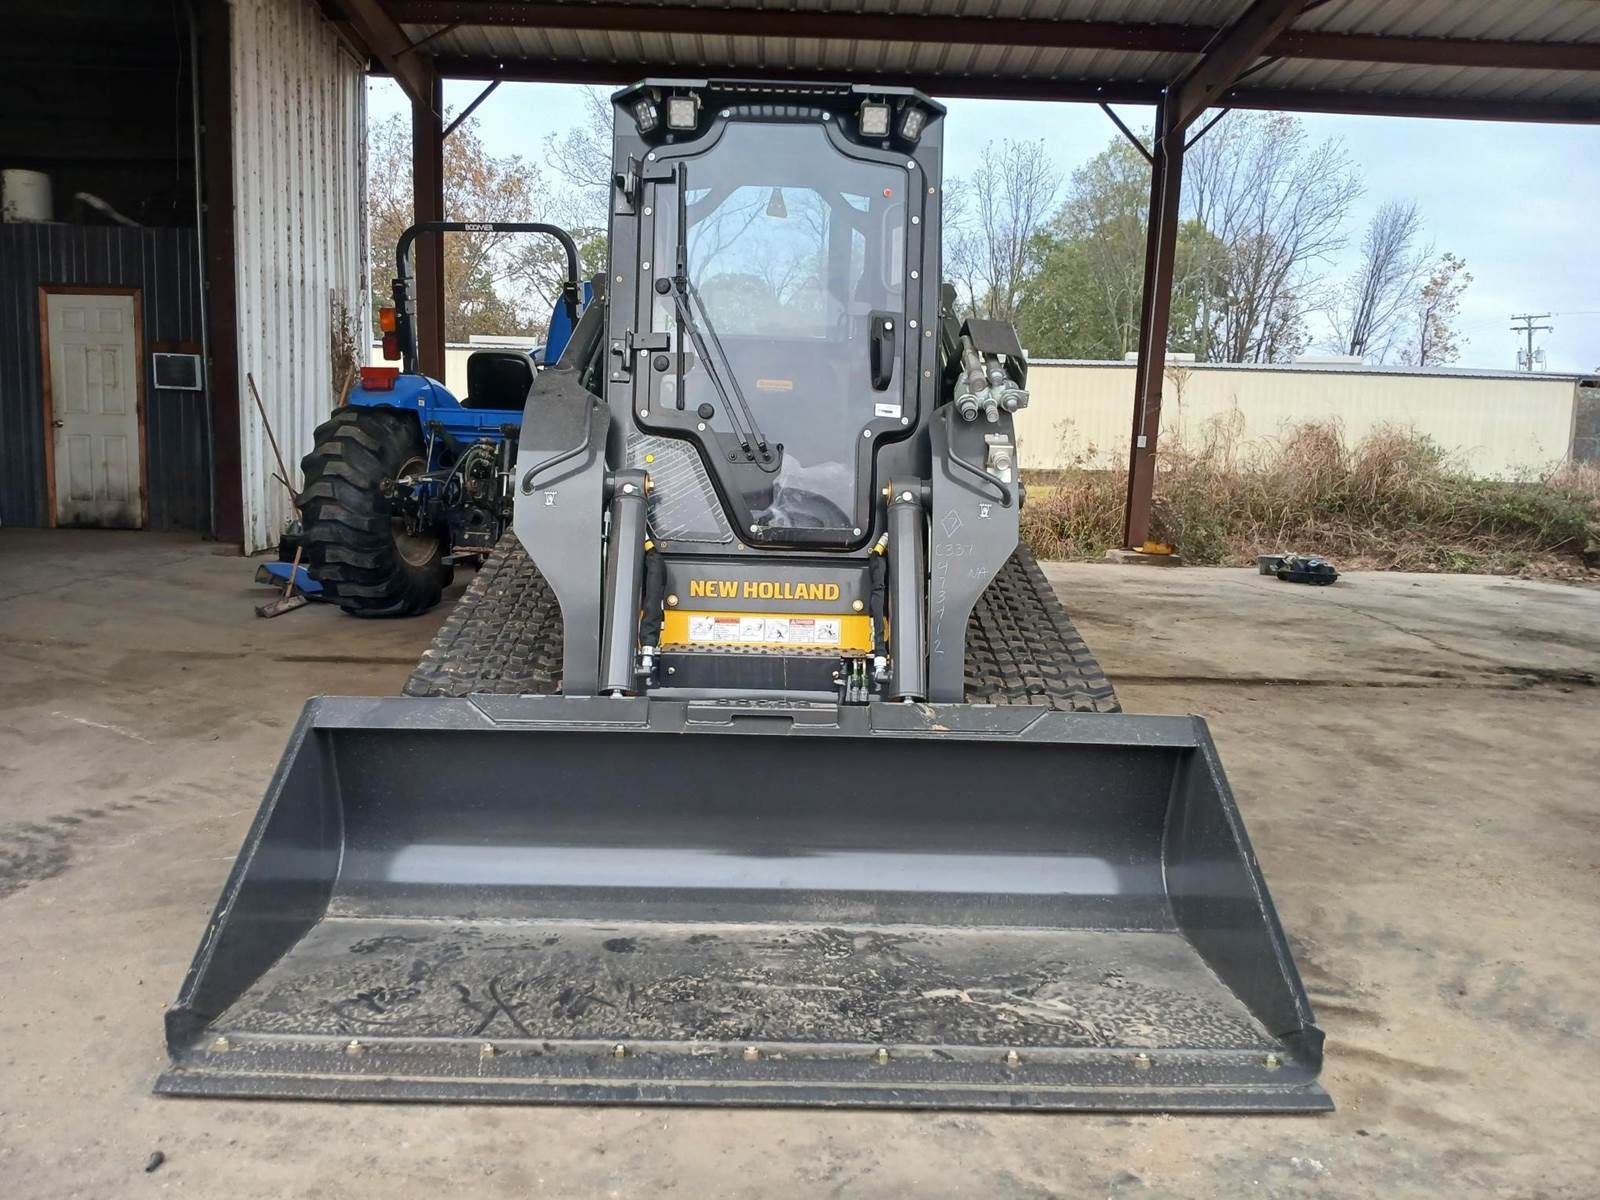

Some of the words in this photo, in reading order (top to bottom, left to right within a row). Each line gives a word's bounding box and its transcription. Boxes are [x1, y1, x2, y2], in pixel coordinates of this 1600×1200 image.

[464, 223, 494, 231] BOOMER
[689, 579, 739, 599] NEW
[743, 581, 841, 601] HOLLAND
